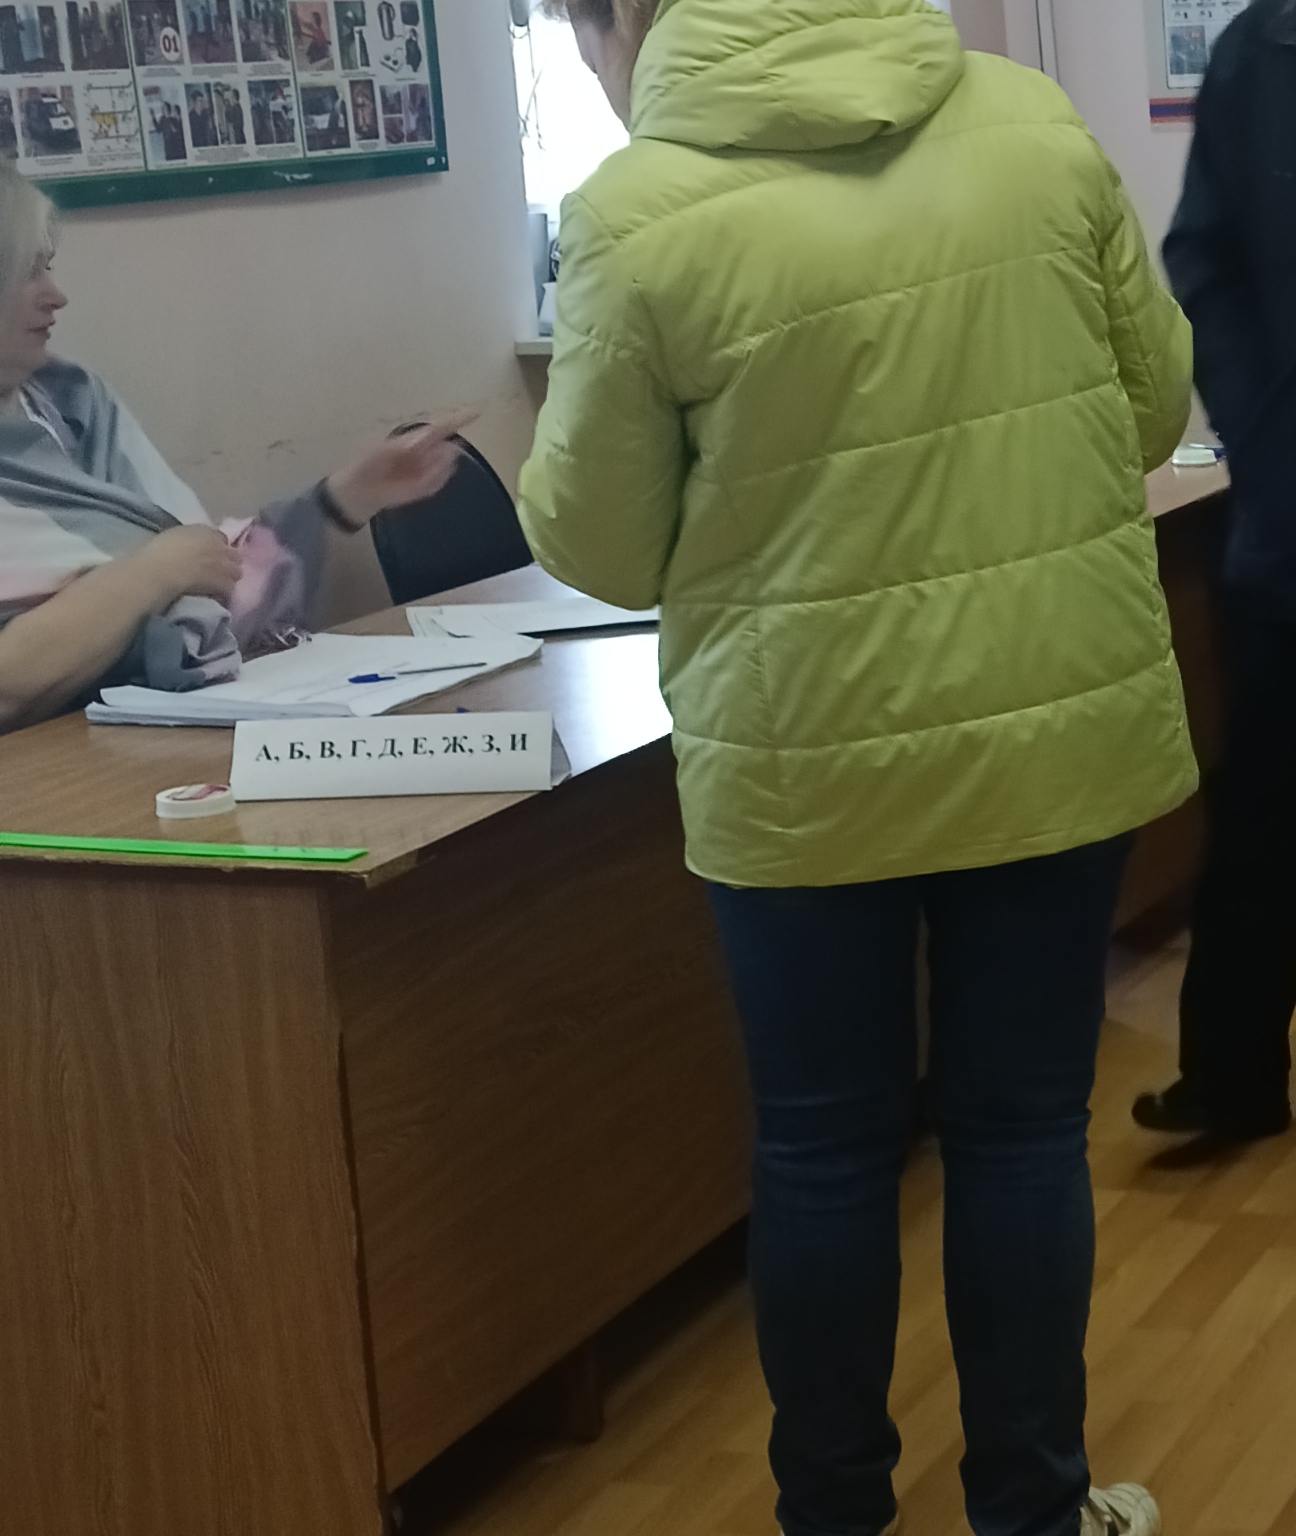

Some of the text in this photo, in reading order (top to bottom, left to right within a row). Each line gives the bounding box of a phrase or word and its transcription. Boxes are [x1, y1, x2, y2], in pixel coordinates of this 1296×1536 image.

[162, 34, 180, 53] 01
[255, 733, 528, 762] А, Б, В, Г, Д, Е, Ж, З, И
